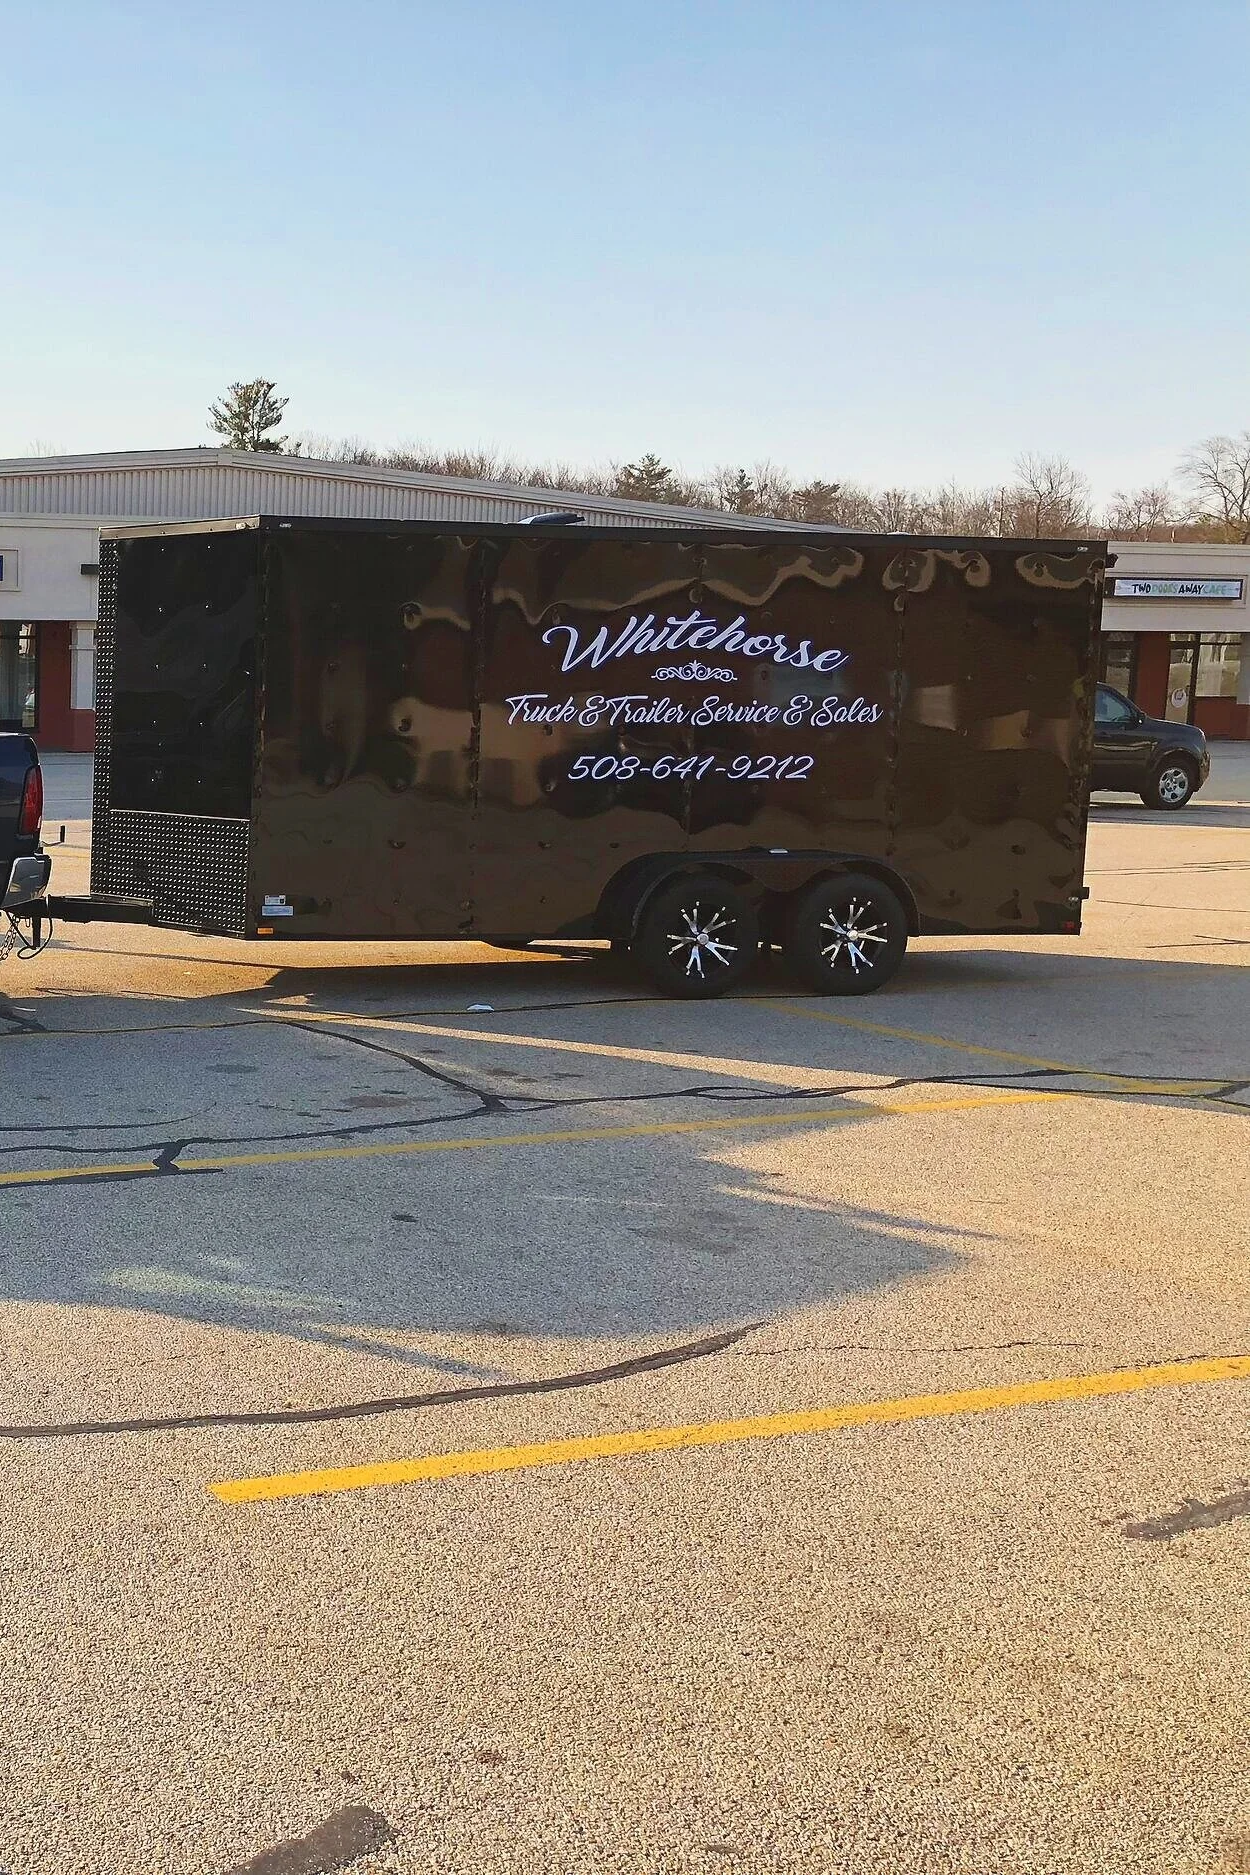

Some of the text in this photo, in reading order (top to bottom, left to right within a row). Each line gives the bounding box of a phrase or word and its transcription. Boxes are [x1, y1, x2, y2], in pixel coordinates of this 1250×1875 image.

[1131, 583, 1151, 593] TWO
[1178, 583, 1204, 594] AWAY
[542, 610, 849, 672] Whitehorse
[505, 694, 883, 727] Truck & Trailer Service & Sales
[567, 754, 815, 780] 508-641-9212
